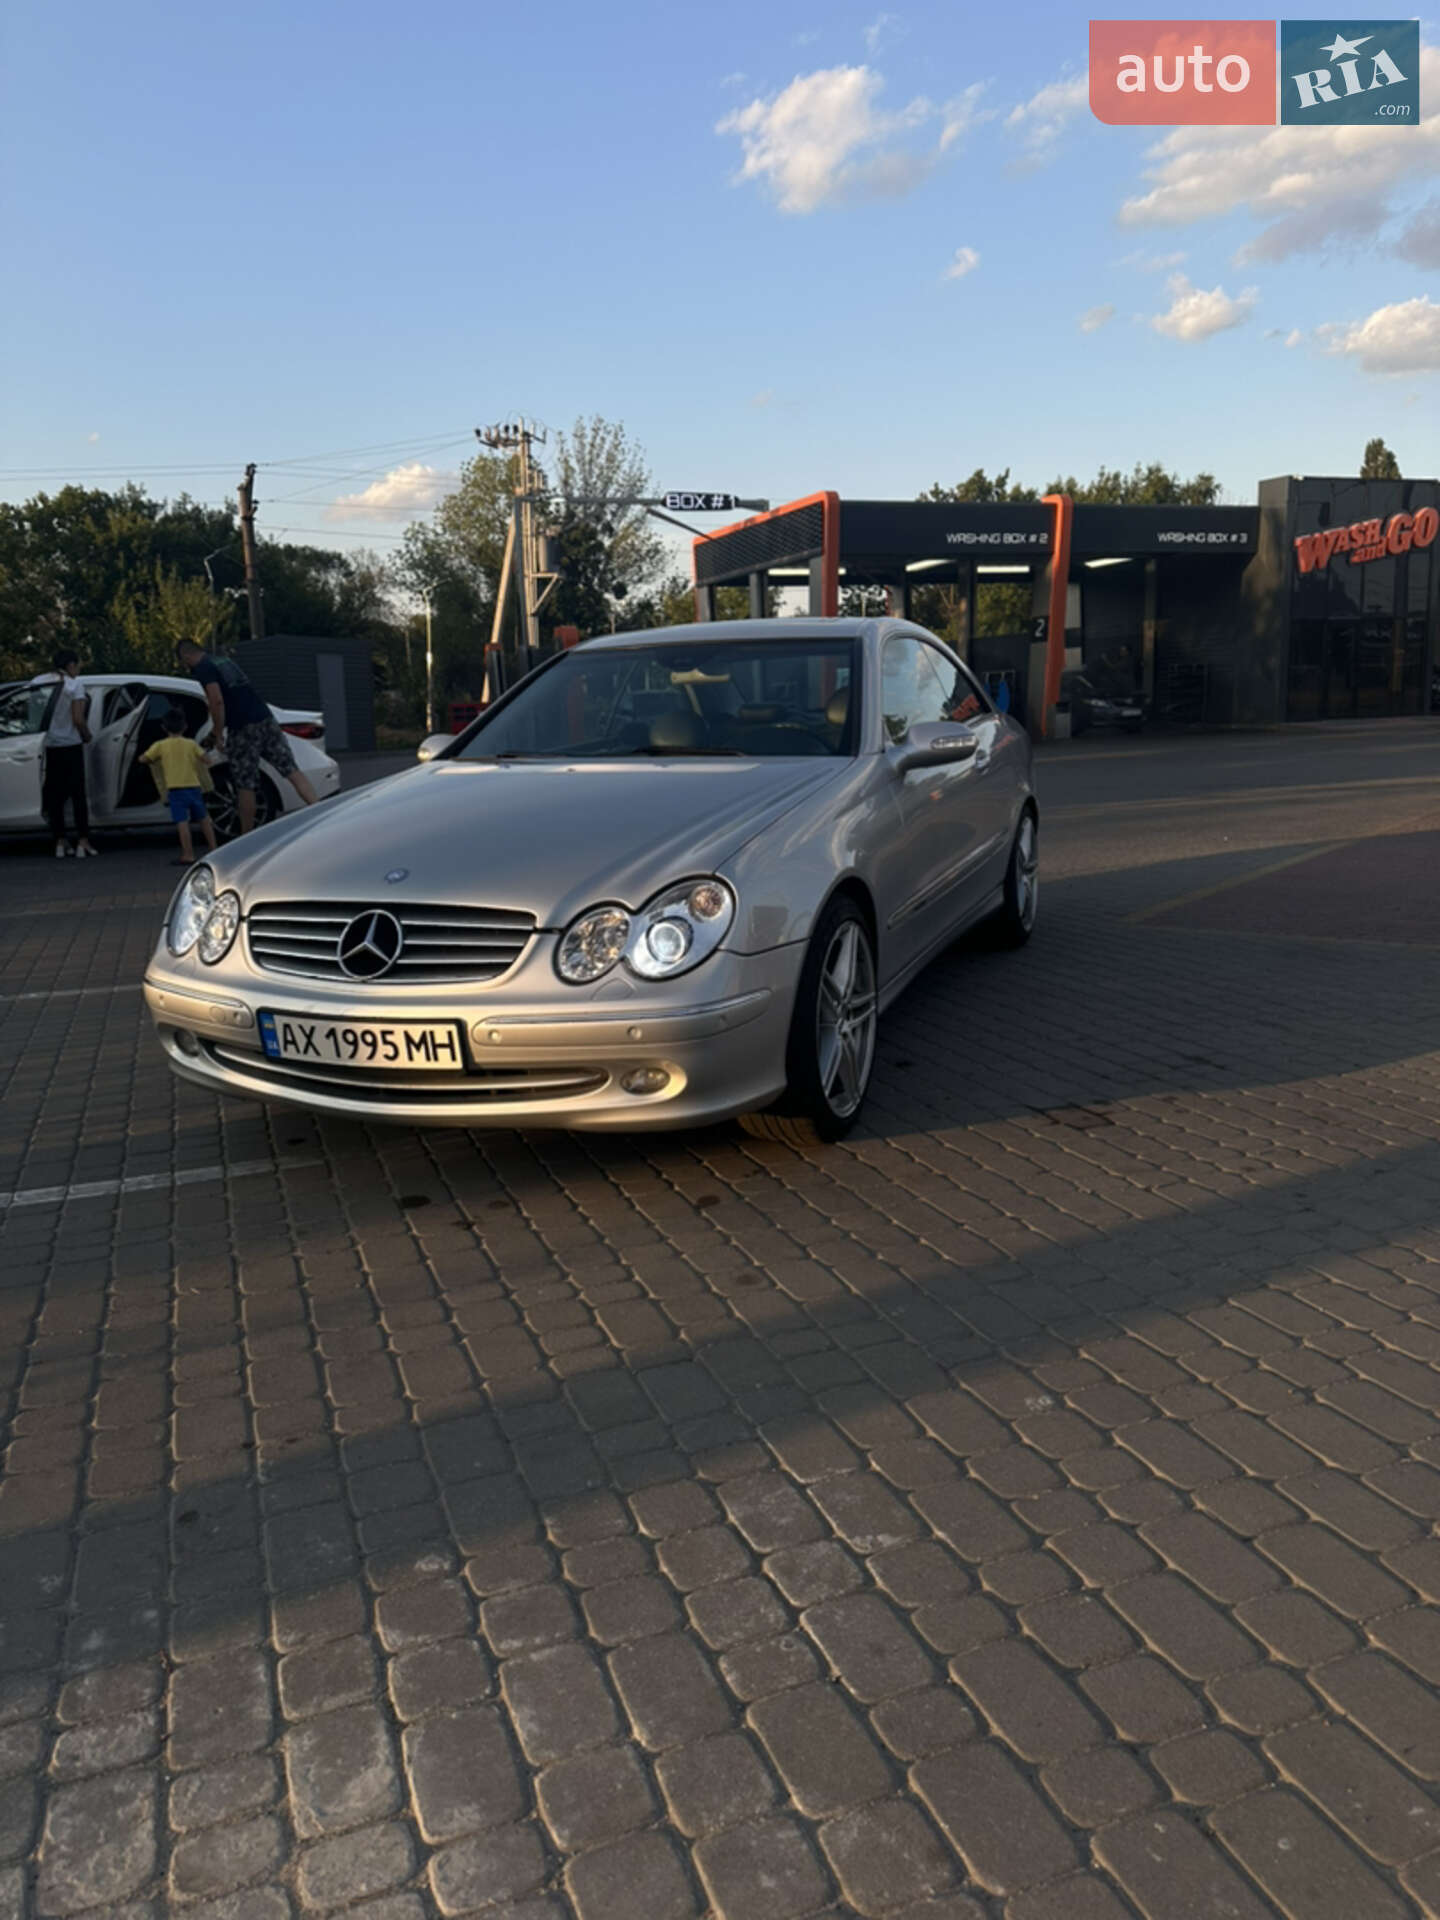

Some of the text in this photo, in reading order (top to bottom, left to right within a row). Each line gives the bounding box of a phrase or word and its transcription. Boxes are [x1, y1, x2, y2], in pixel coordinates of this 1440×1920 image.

[665, 493, 707, 509] BOX
[711, 494, 724, 509] #
[946, 532, 1001, 544] WASHING
[1002, 532, 1027, 544] BOX
[1039, 532, 1049, 544] 2
[1157, 531, 1206, 544] WASHING
[1207, 532, 1229, 544] BOX
[1239, 532, 1248, 544] 3
[1294, 517, 1381, 573] WASH
[1387, 506, 1440, 555] GO
[1035, 618, 1045, 637] 2
[283, 1023, 457, 1062] AX 1995 MH
